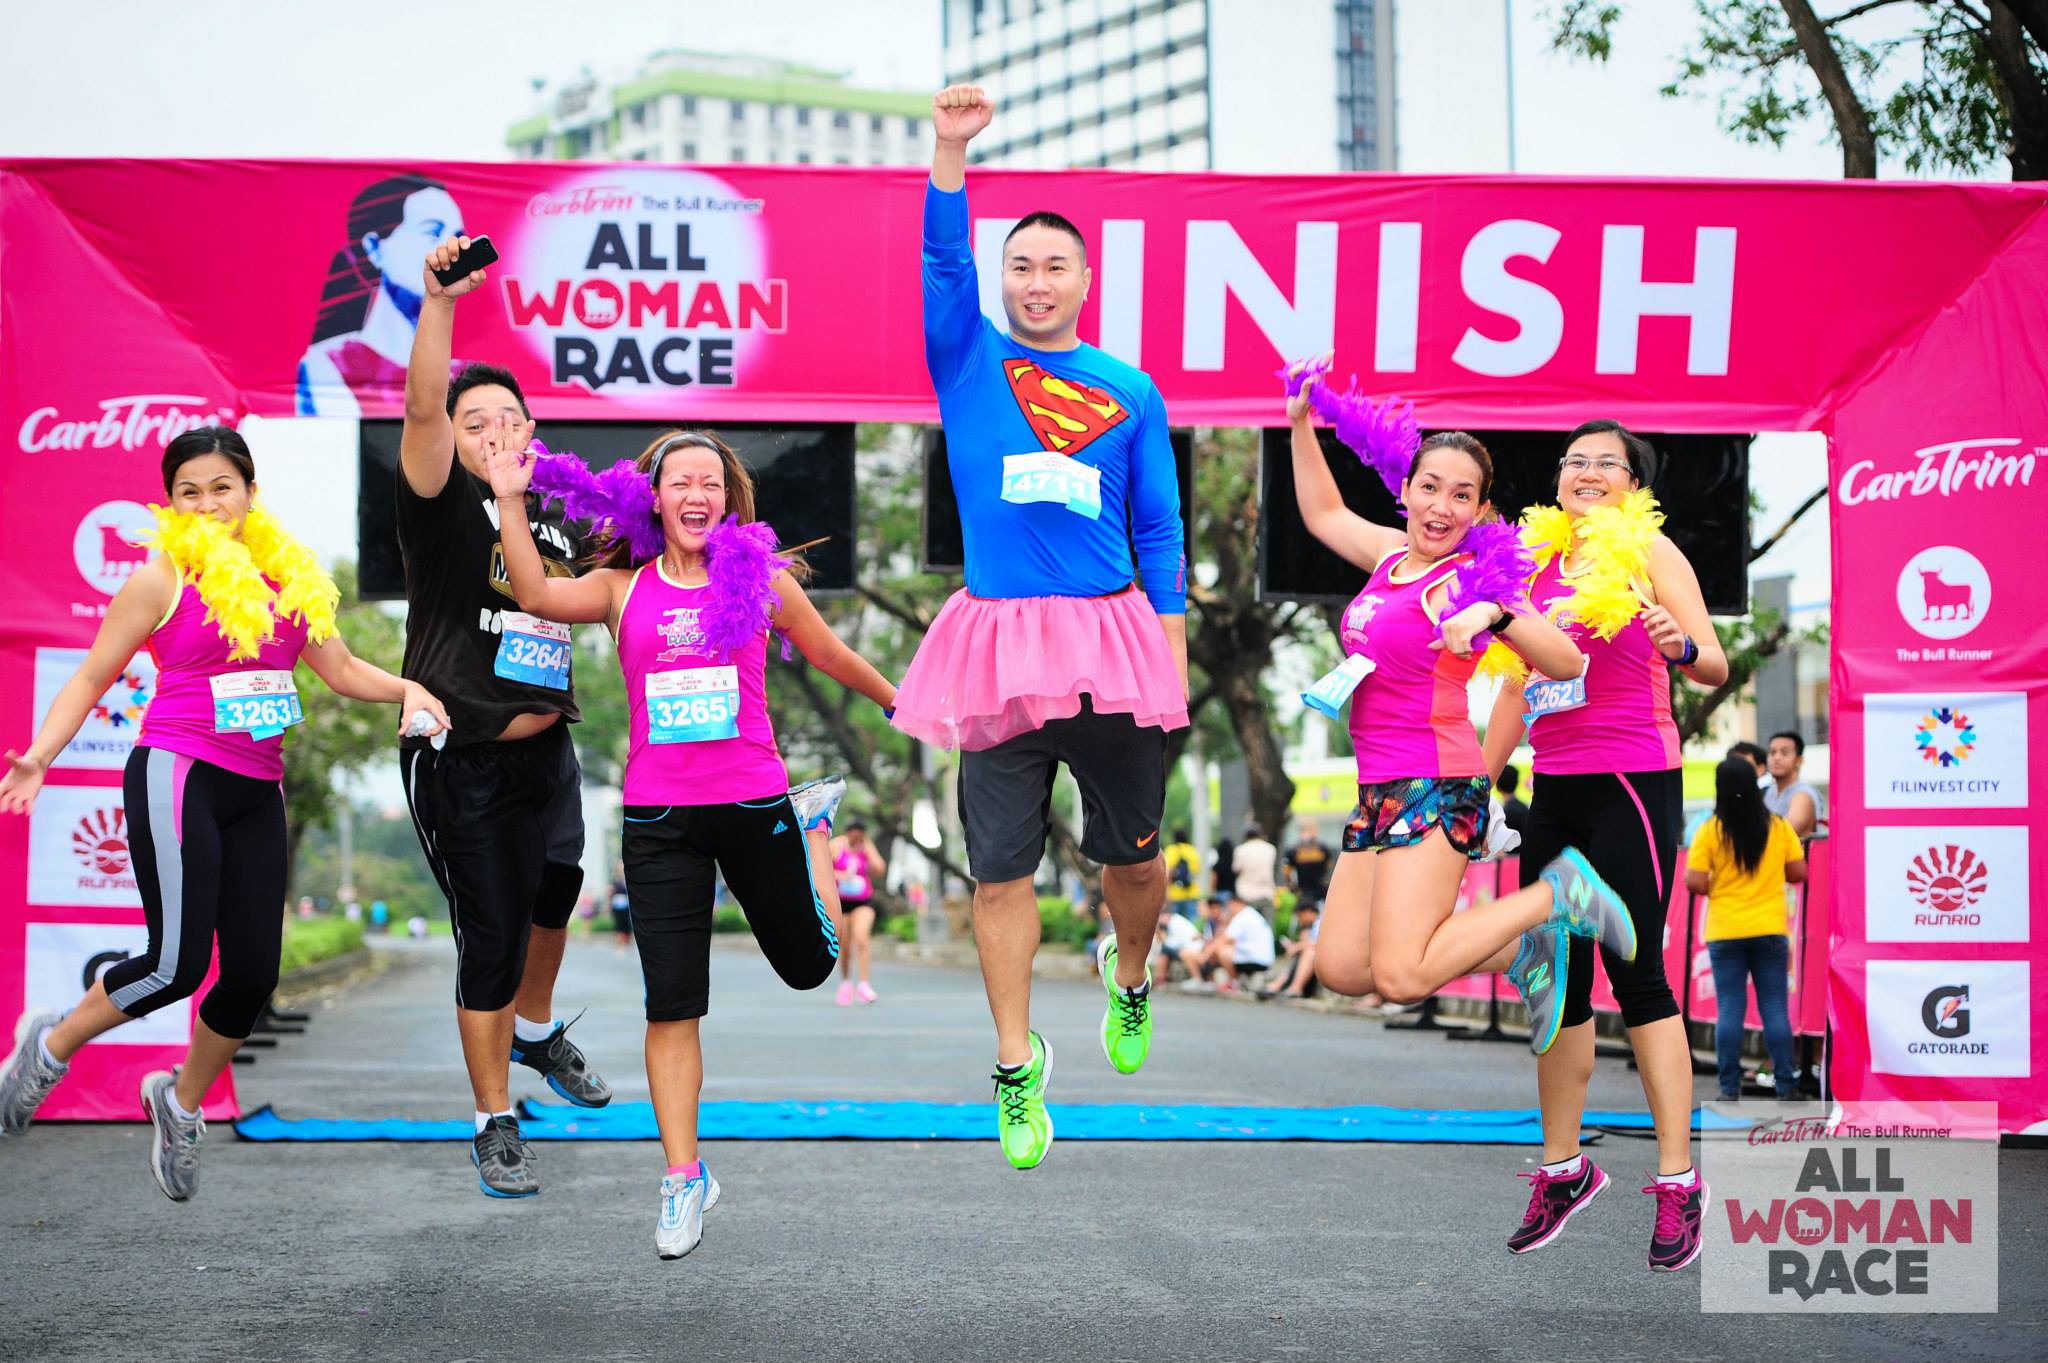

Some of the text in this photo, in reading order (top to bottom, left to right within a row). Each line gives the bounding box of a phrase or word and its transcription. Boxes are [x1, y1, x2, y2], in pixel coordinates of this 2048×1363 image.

[528, 186, 763, 216] CarbTrim The Bull Runner
[585, 223, 706, 271] ALL
[505, 279, 783, 329] WOMAN
[973, 217, 1738, 377] INISH
[555, 337, 733, 390] RACE
[1013, 473, 1085, 499] 4711
[1838, 438, 2036, 506] CarbTrim
[506, 637, 562, 671] 3264
[1897, 648, 1992, 661] The Bull Runner
[226, 699, 292, 728] 3263
[656, 696, 728, 728] 3265
[64, 740, 133, 753] ILINVES
[1892, 780, 2000, 793] FILINVEST CITY
[79, 876, 137, 889] RUNRI
[1915, 914, 1981, 925] RUNRIO
[1908, 1043, 1989, 1055] GATORADE
